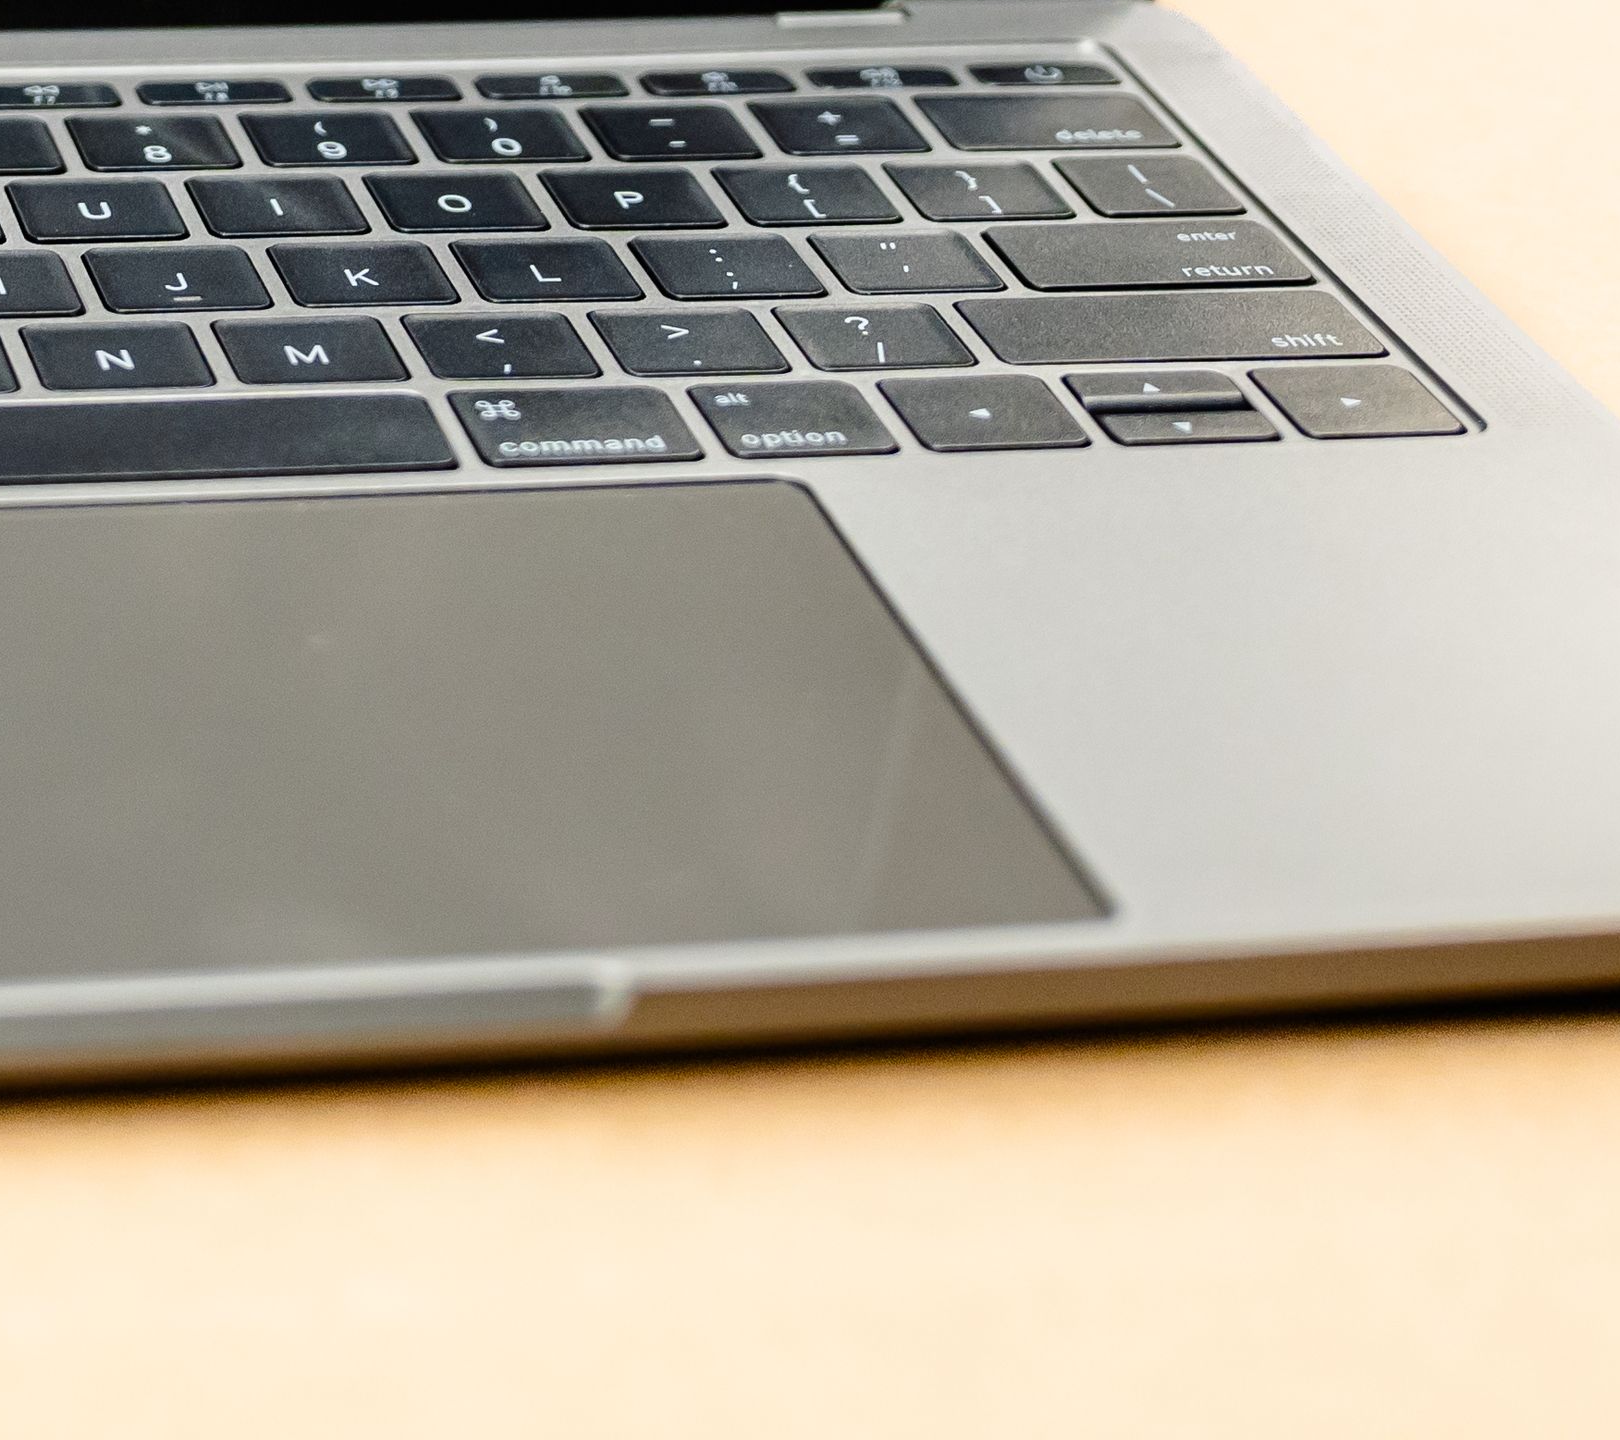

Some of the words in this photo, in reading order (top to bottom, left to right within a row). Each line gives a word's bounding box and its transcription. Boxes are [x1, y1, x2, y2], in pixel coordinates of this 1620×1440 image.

[144, 146, 171, 162] 8
[318, 142, 347, 159] 9
[438, 195, 471, 212] O
[614, 191, 643, 208] P
[78, 202, 111, 219] U
[1177, 232, 1236, 241] enter
[344, 269, 379, 286] K
[530, 265, 561, 282] L
[1182, 265, 1274, 276] return
[165, 273, 187, 291] J
[1272, 334, 1343, 347] shift
[96, 350, 134, 370] N
[284, 345, 329, 365] M
[715, 393, 749, 406] alt
[499, 435, 666, 458] command
[740, 430, 847, 449] option
